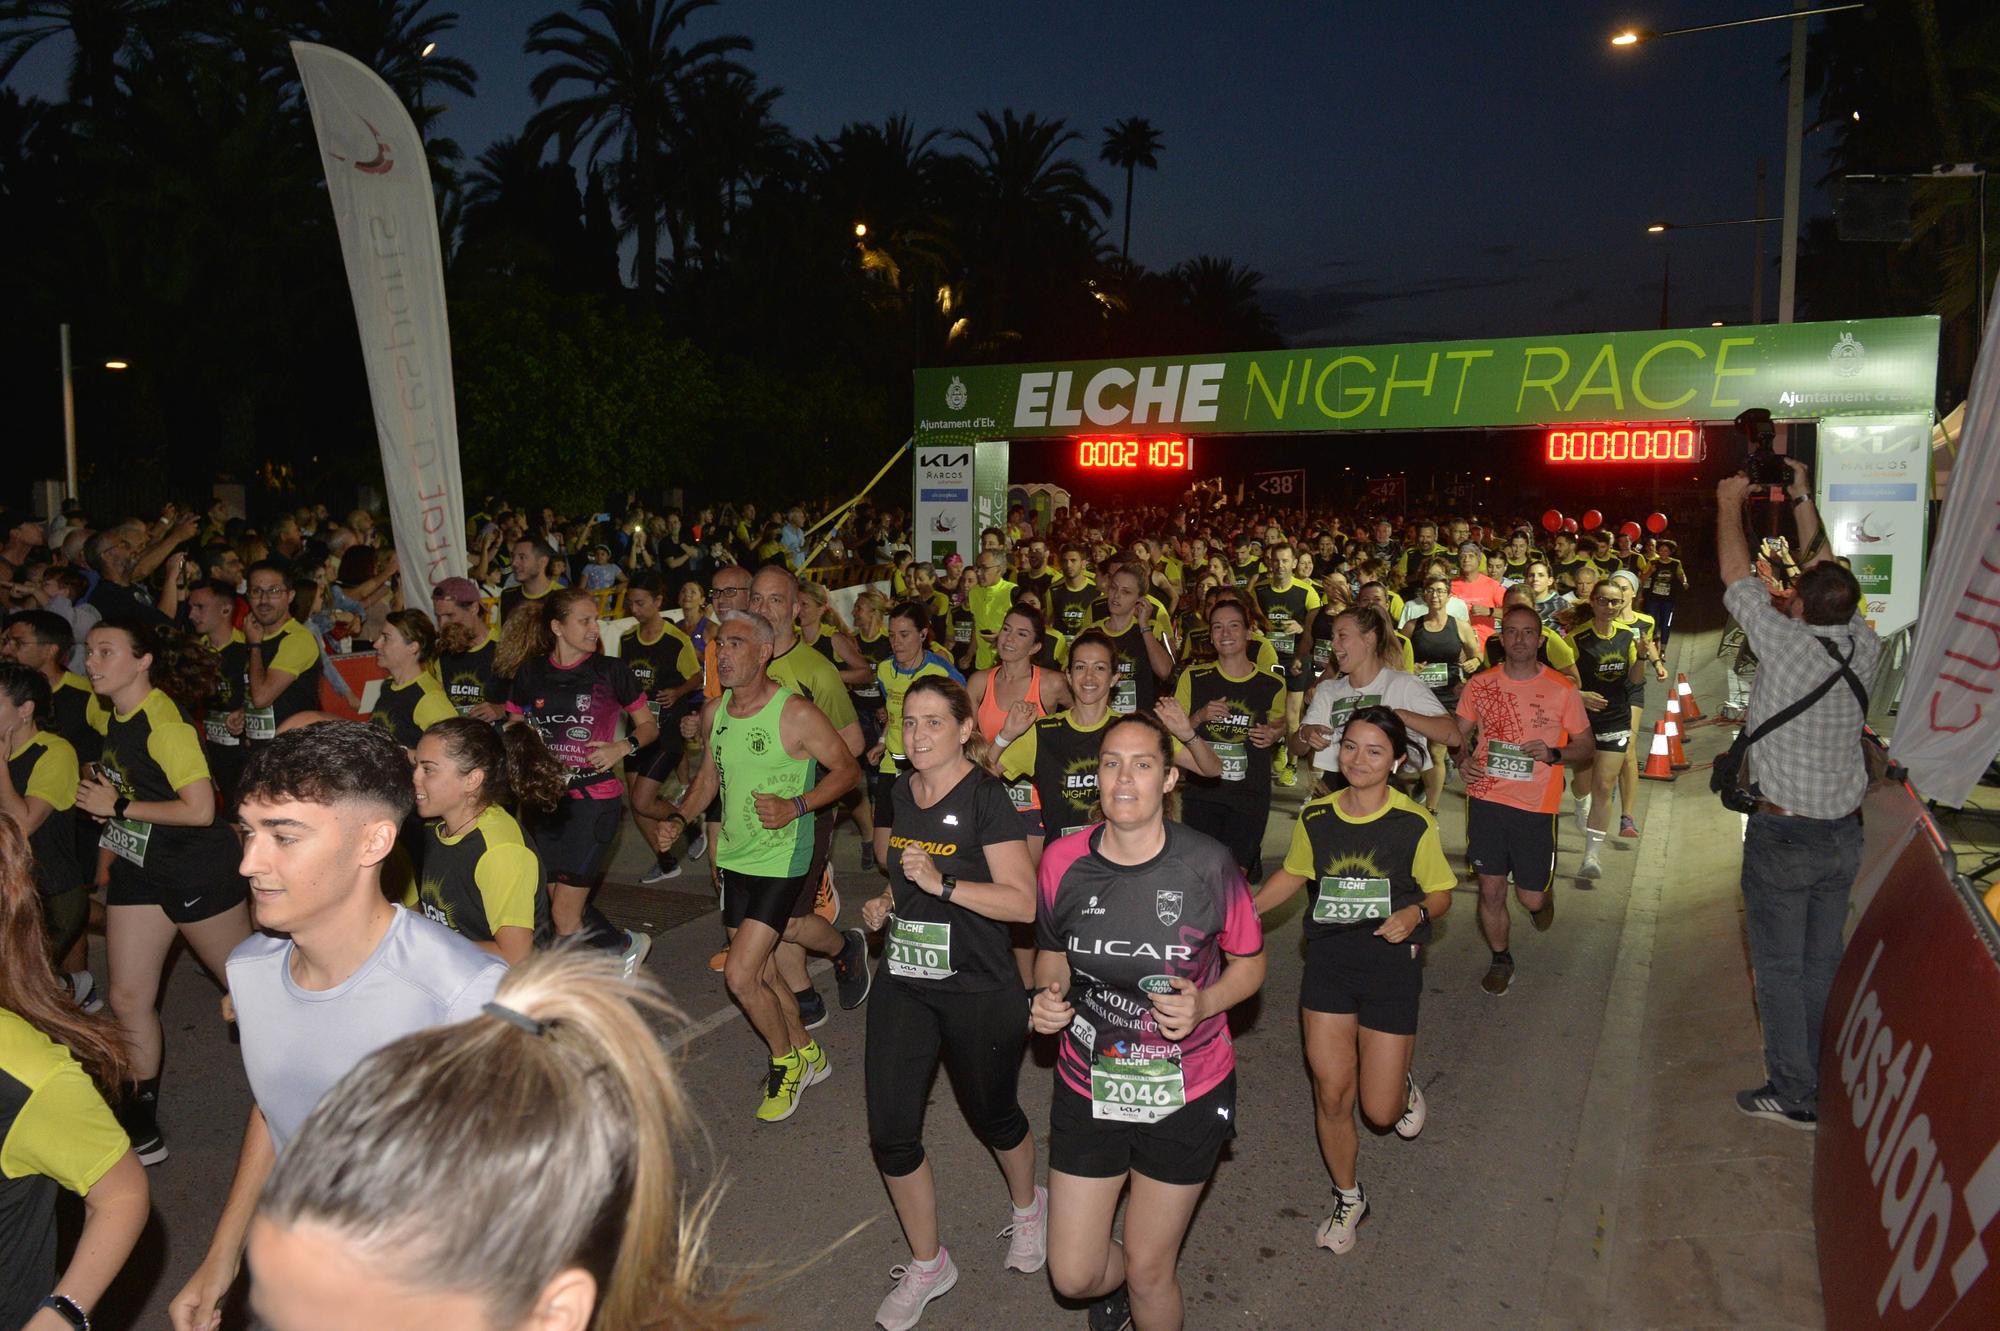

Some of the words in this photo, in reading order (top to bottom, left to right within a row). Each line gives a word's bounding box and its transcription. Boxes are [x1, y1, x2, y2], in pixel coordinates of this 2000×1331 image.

[1013, 363, 1226, 428] ELCHE
[1244, 350, 1494, 420] NIGHT
[1516, 337, 1757, 413] RACE
[1779, 391, 1870, 407] Ajuntament
[920, 418, 971, 432] Ajuntament
[973, 417, 996, 429] d'Elx
[921, 453, 969, 467] KIA
[1598, 662, 1625, 672] ELCHE
[451, 684, 480, 696] ELCHE
[1206, 724, 1230, 733] NIGHT
[1232, 725, 1249, 735] RAC
[1492, 757, 1528, 772] 2365
[1062, 789, 1093, 799] NIGHT
[107, 825, 138, 853] 2082
[1339, 881, 1367, 890] ELCHE
[1325, 903, 1379, 919] 2376
[897, 922, 925, 934] ELCHE
[890, 943, 938, 967] 2110
[1149, 979, 1170, 987] LAN
[1131, 1042, 1182, 1054] MEDIA
[1104, 1080, 1171, 1106] 2046
[1836, 939, 1953, 1318] lastlap
